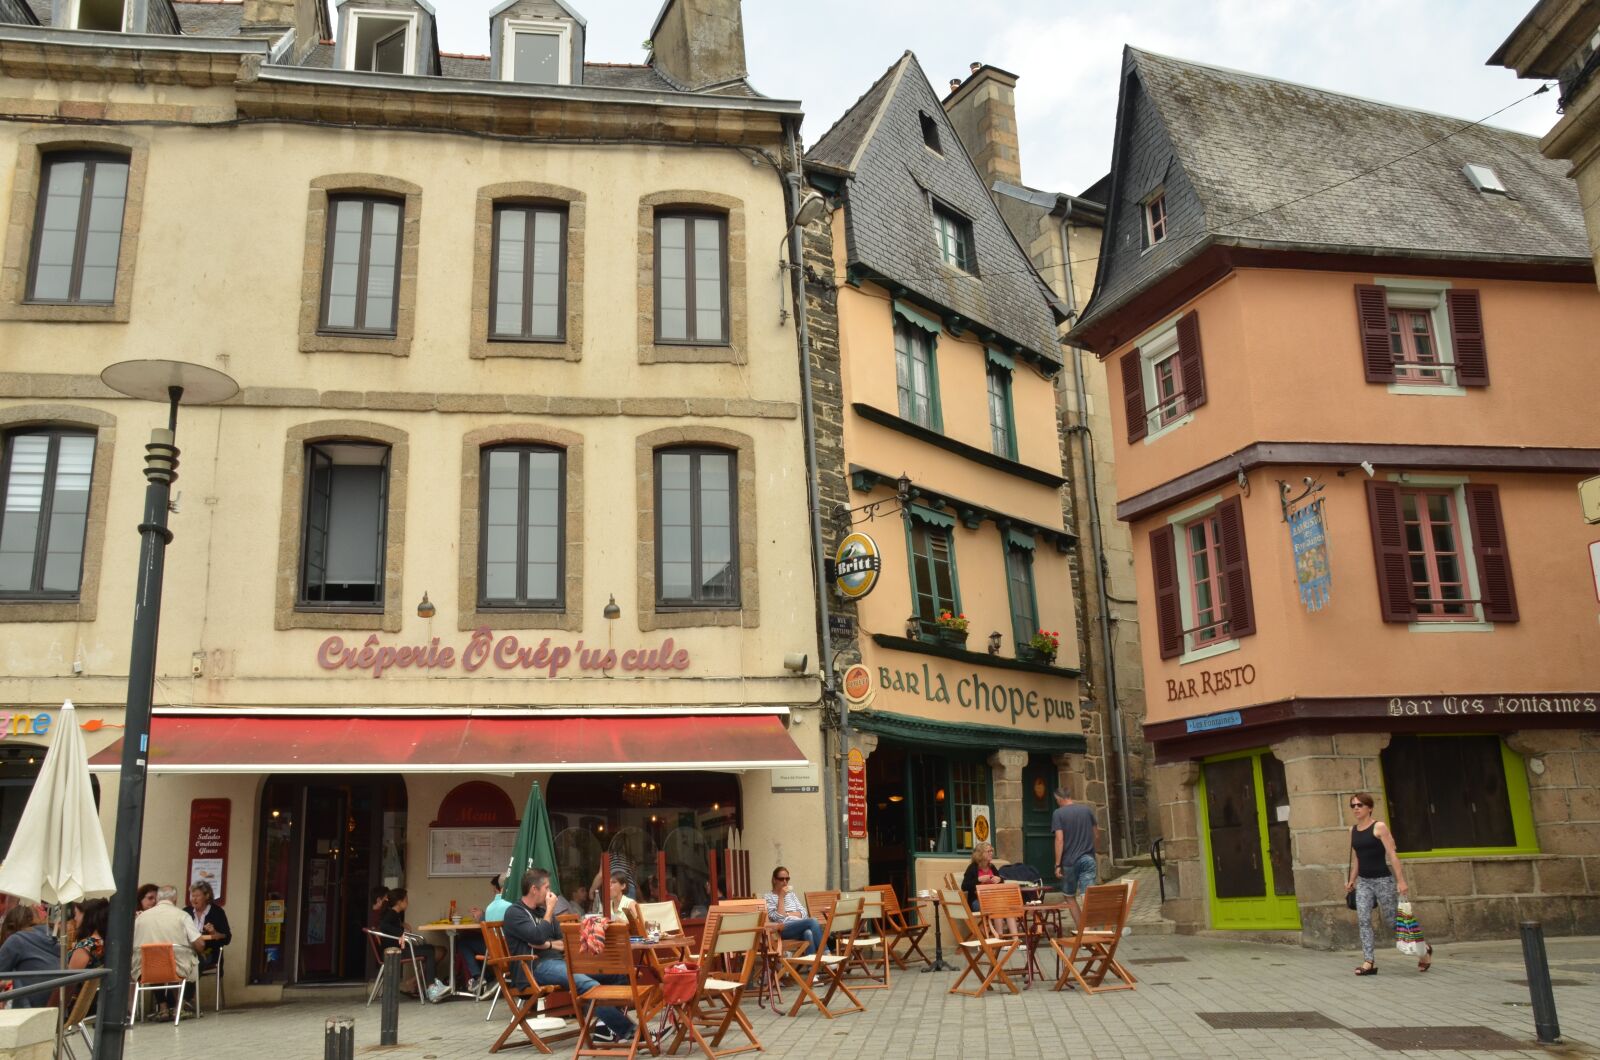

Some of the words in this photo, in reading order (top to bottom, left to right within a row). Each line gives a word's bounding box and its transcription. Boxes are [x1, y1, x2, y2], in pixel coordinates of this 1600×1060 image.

[838, 557, 872, 575] Britt
[317, 633, 456, 679] Crêperie
[461, 624, 493, 672] Ô
[1165, 678, 1200, 702] BAR
[1200, 663, 1256, 696] RESTO
[1388, 696, 1433, 717] Bar
[200, 826, 219, 834] Crêpes
[198, 847, 218, 855] Glaces
